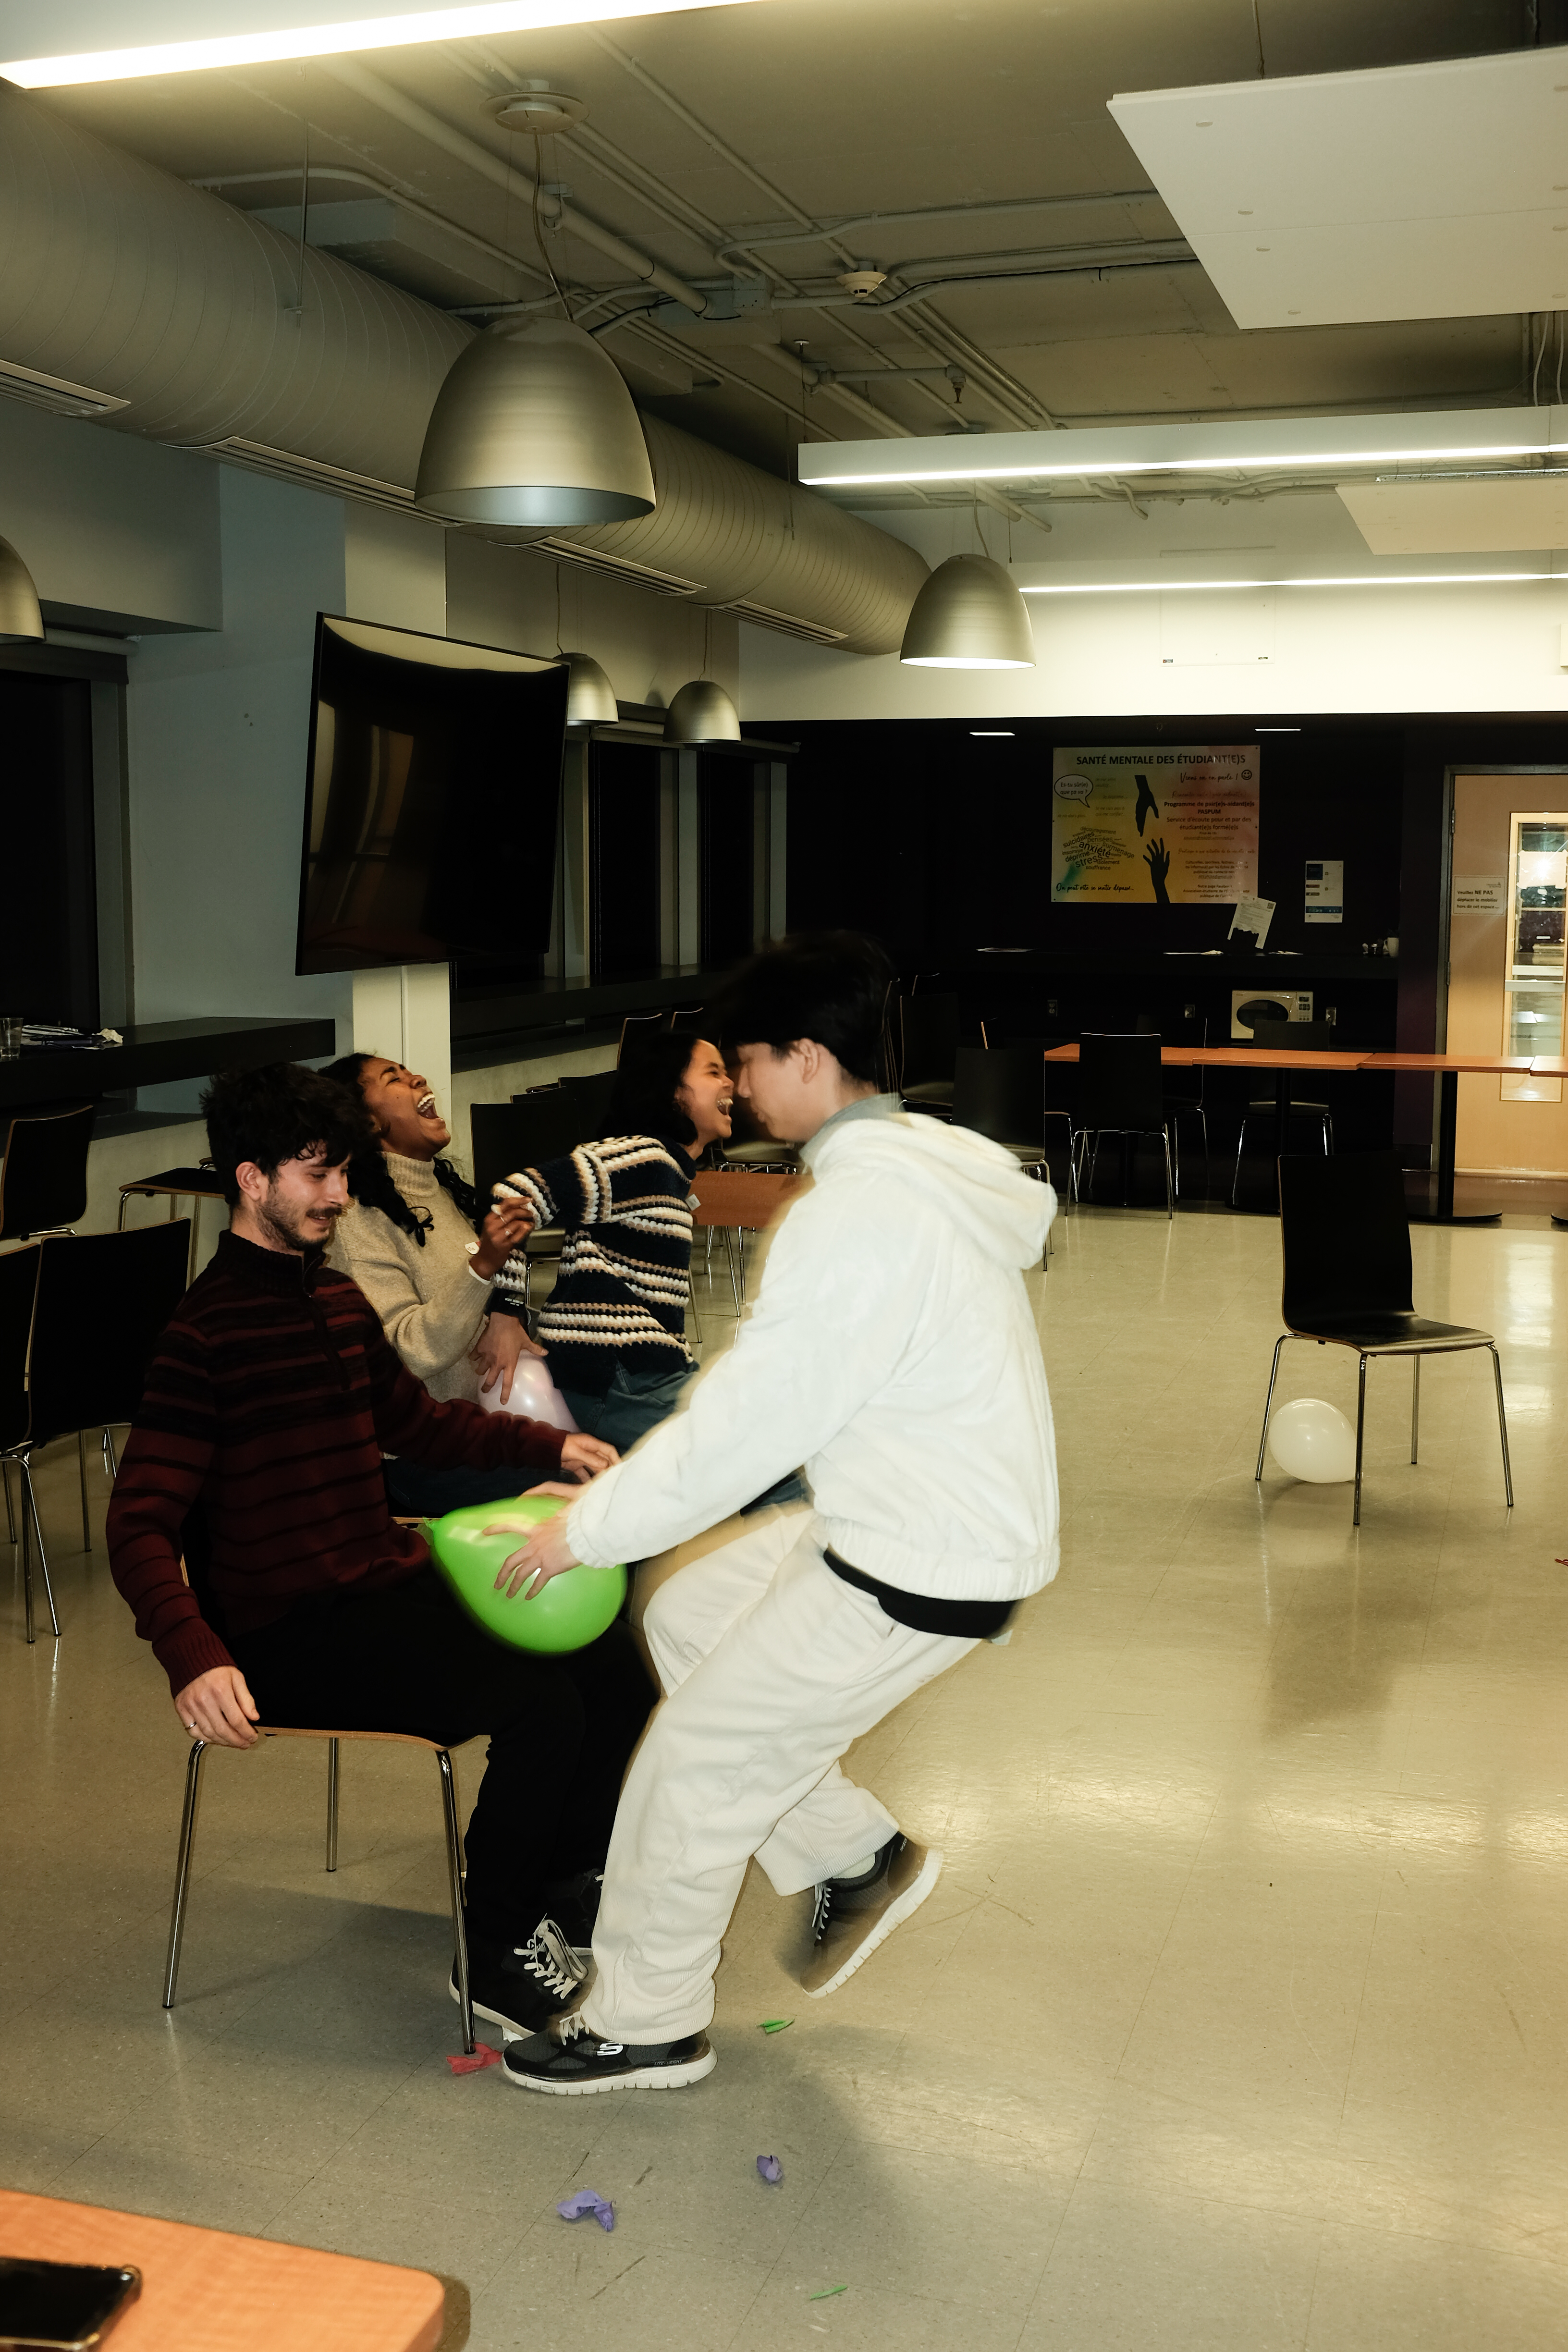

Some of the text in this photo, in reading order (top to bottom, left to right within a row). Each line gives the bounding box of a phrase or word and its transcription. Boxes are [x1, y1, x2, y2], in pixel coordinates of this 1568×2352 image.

[1077, 753, 1246, 765] SANTÉ MENTALE DES ÉTUDIANT(E)S
[1080, 826, 1116, 834] découragement
[1063, 832, 1095, 848] suicidaires
[1065, 851, 1090, 862] déprime
[1079, 842, 1111, 858] anxiété
[1102, 842, 1135, 858] surmenage
[1076, 854, 1103, 868] stress
[1056, 882, 1065, 891] On
[1067, 884, 1079, 893] peut
